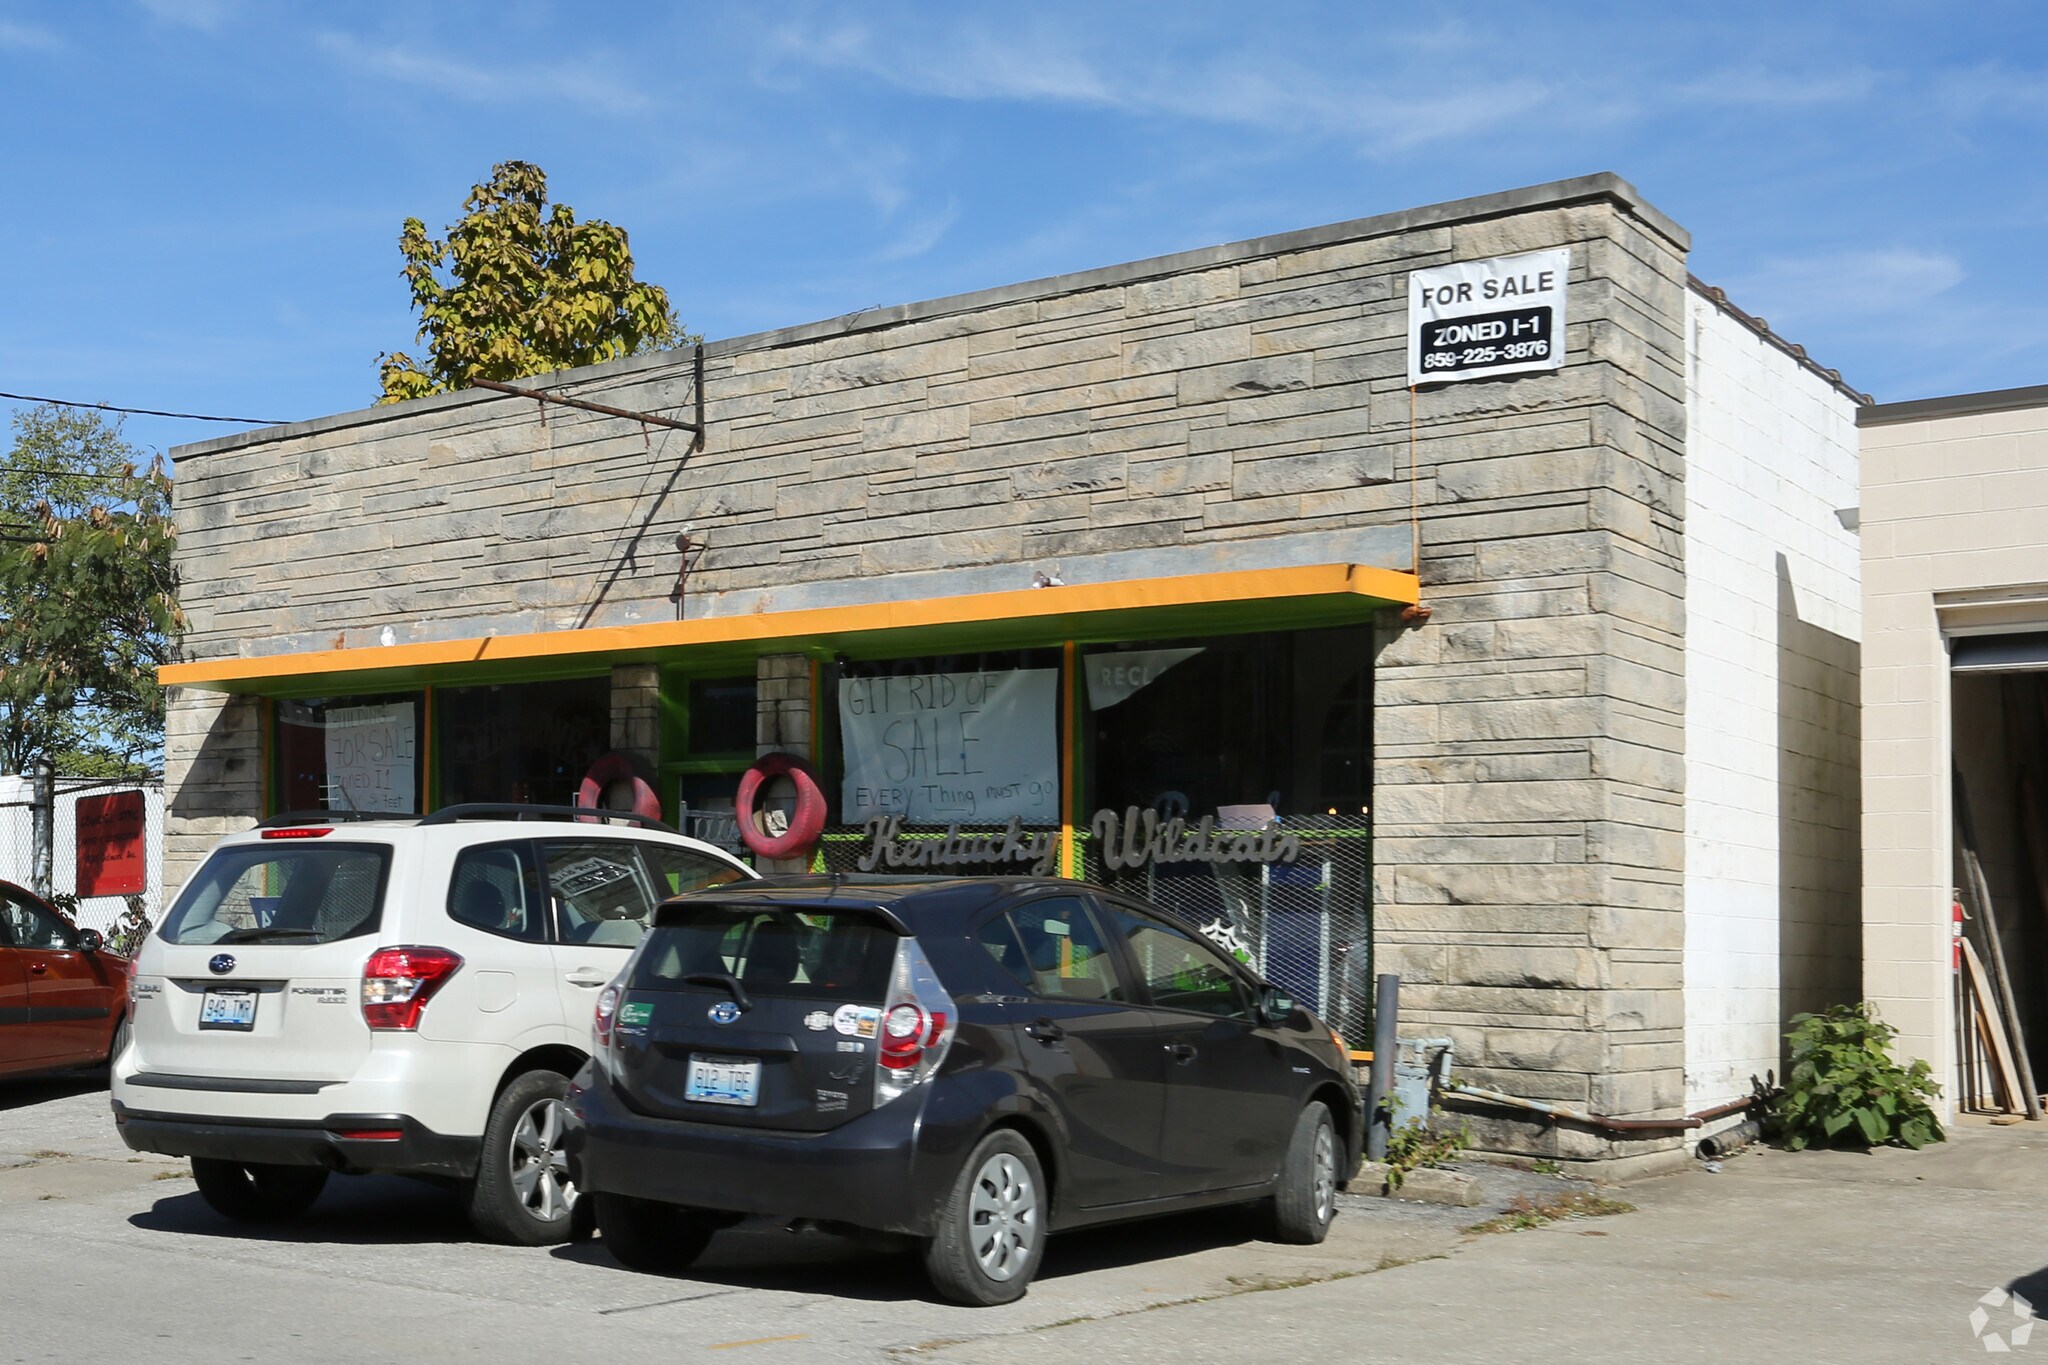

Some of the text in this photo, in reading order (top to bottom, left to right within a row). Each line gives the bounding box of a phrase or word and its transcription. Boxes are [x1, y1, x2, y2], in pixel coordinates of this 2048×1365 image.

[1422, 271, 1554, 308] FOR SALE
[1433, 316, 1539, 347] ZONED I-1
[1424, 340, 1548, 369] 859-225-3876
[849, 674, 999, 715] GIT RID OF
[1102, 666, 1166, 686] RECL
[330, 726, 413, 766] FOR SALE
[882, 710, 984, 782] SALE
[1029, 780, 1053, 806] go
[858, 805, 1300, 876] Kentucky Wildcats
